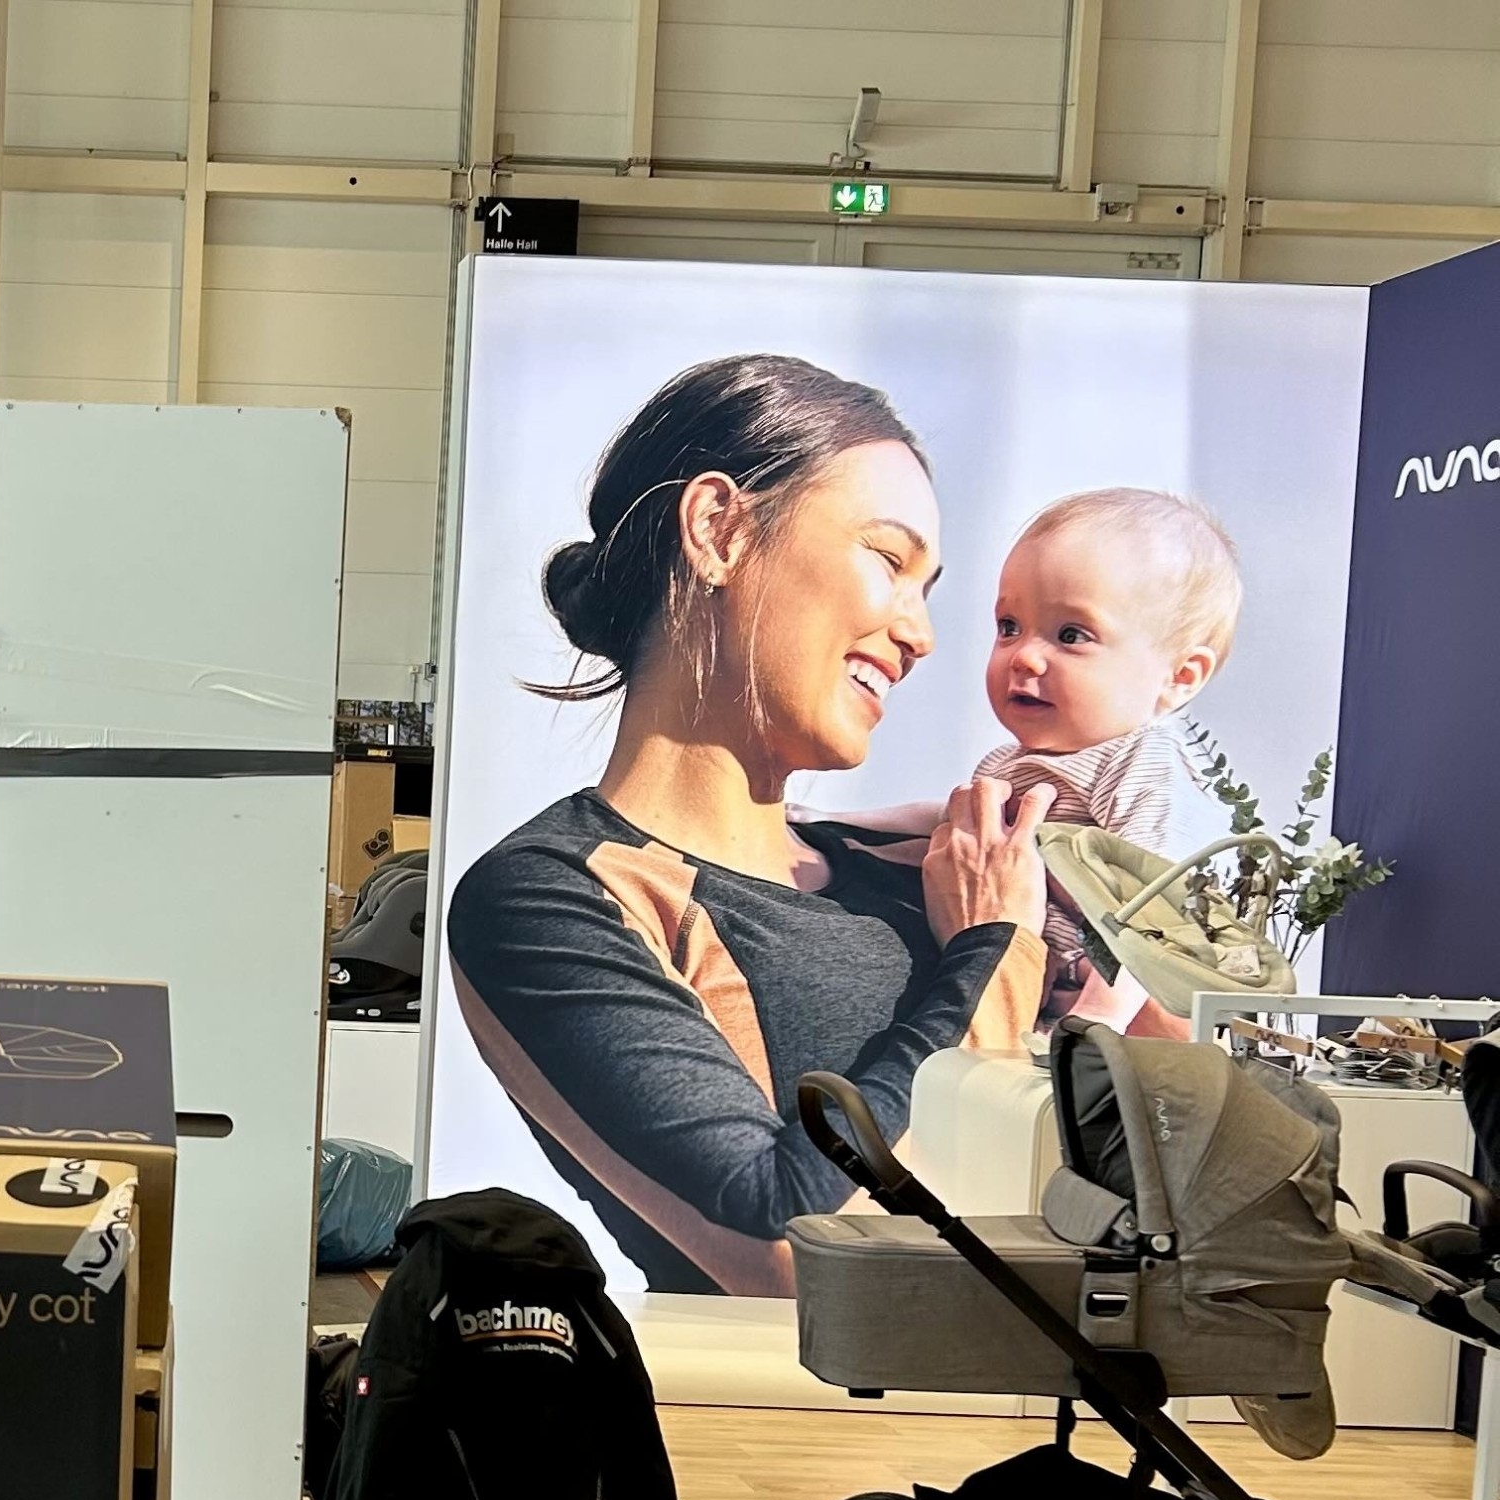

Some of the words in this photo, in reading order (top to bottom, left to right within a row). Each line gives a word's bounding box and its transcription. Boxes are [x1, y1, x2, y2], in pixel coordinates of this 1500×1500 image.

[486, 238, 514, 250] Halle
[516, 239, 538, 251] Hall
[65, 983, 109, 993] cot
[1154, 1097, 1172, 1142] nuna
[29, 1284, 97, 1325] cot
[454, 1300, 575, 1347] bachmey
